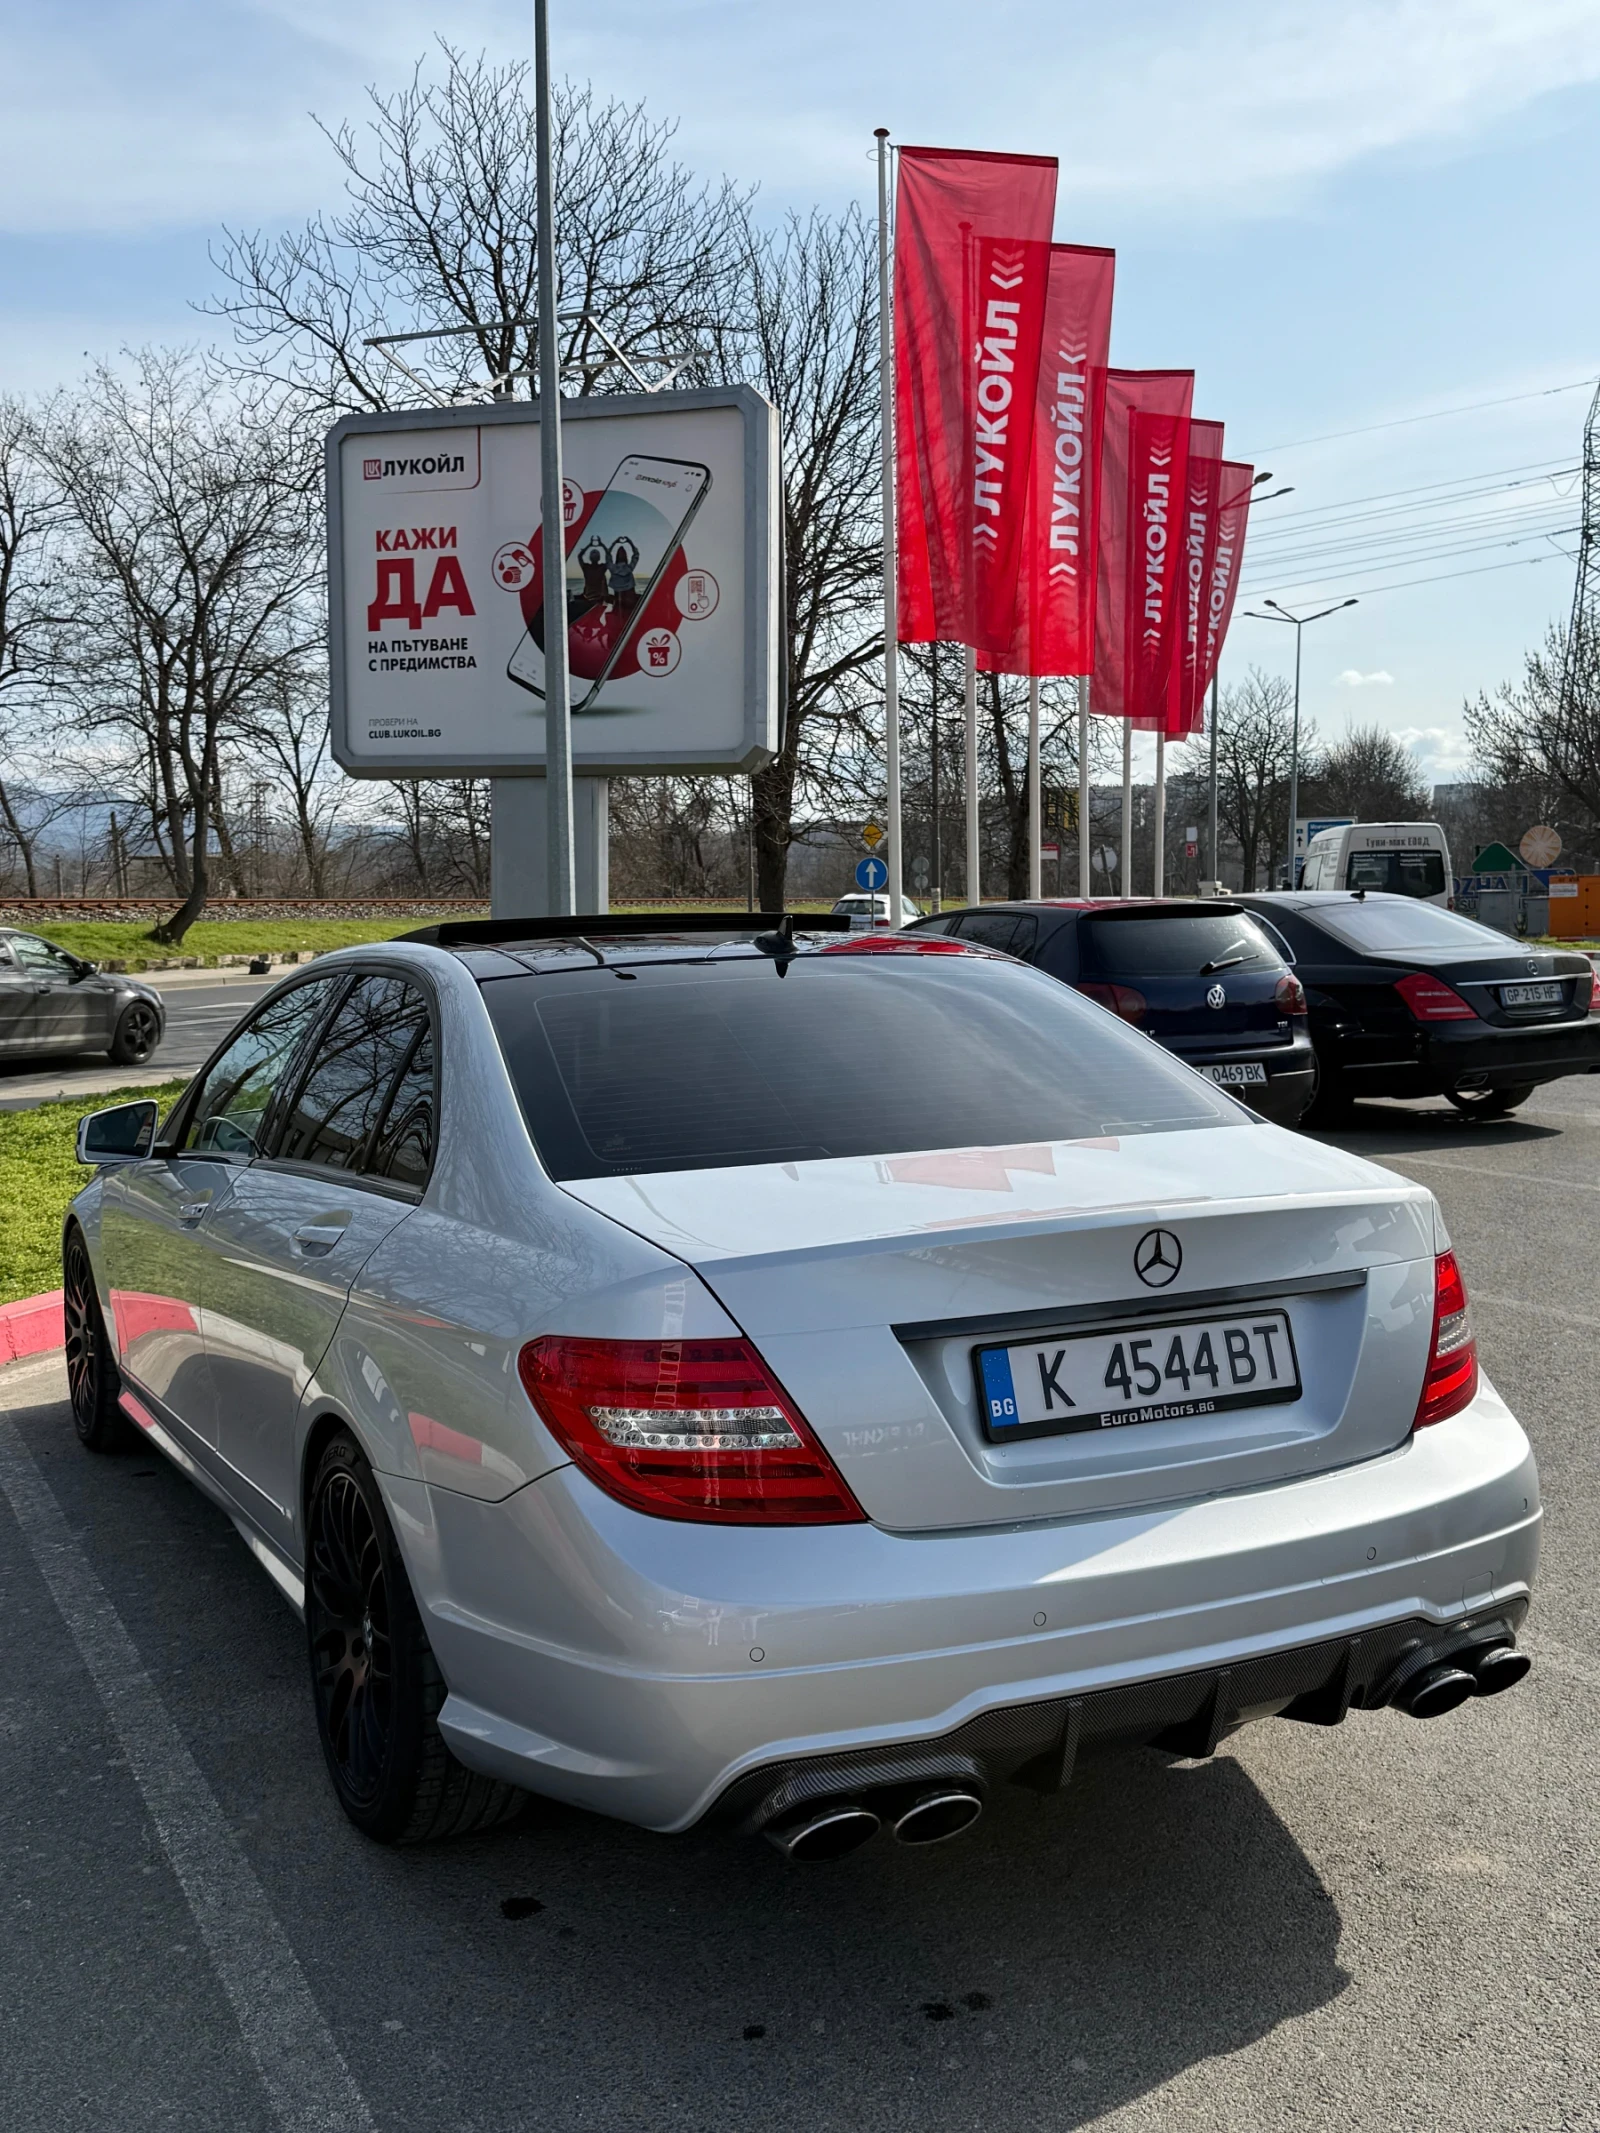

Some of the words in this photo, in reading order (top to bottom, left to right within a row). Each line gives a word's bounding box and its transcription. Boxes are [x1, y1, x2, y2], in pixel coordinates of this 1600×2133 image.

[974, 300, 1020, 516] ЛУКОЙЛ
[383, 453, 464, 477] ЛУКОЙЛ
[1050, 372, 1085, 556] ЛУКОЙЛ
[376, 526, 457, 552] КАЖИ
[1143, 474, 1170, 623] ЛУКОЙЛ
[368, 556, 476, 632] ДА
[368, 641, 388, 654] НА
[391, 638, 468, 653] ПЪТУВАНЕ
[368, 659, 377, 672] С
[381, 656, 477, 673] ПРЕДИМСТВА
[368, 718, 405, 727] ПРОВЕРИ
[406, 718, 418, 726] НА
[368, 729, 442, 739] CLUB.LUKOIL.BG
[1036, 1350, 1076, 1410] K
[991, 1398, 1015, 1418] BG
